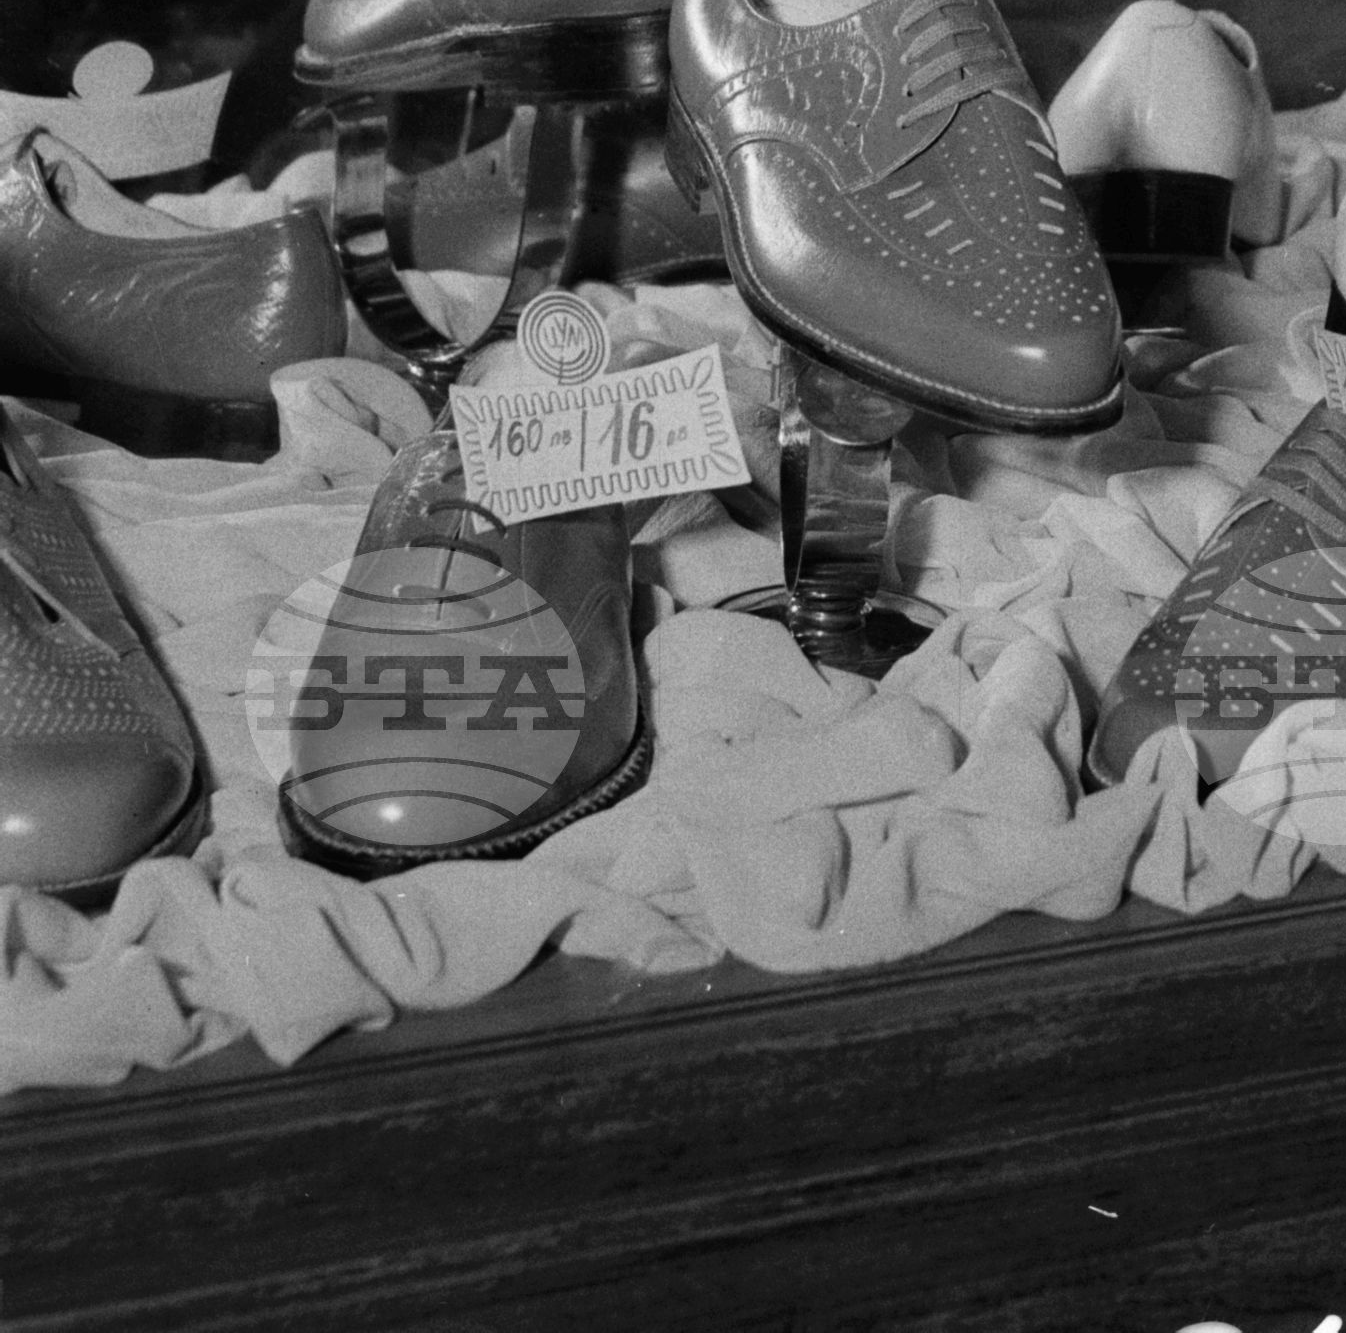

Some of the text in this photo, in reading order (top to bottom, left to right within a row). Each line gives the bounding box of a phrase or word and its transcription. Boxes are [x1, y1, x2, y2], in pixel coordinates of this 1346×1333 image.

[543, 316, 585, 349] ЦУМ
[488, 418, 543, 462] 160
[598, 400, 655, 466] 16
